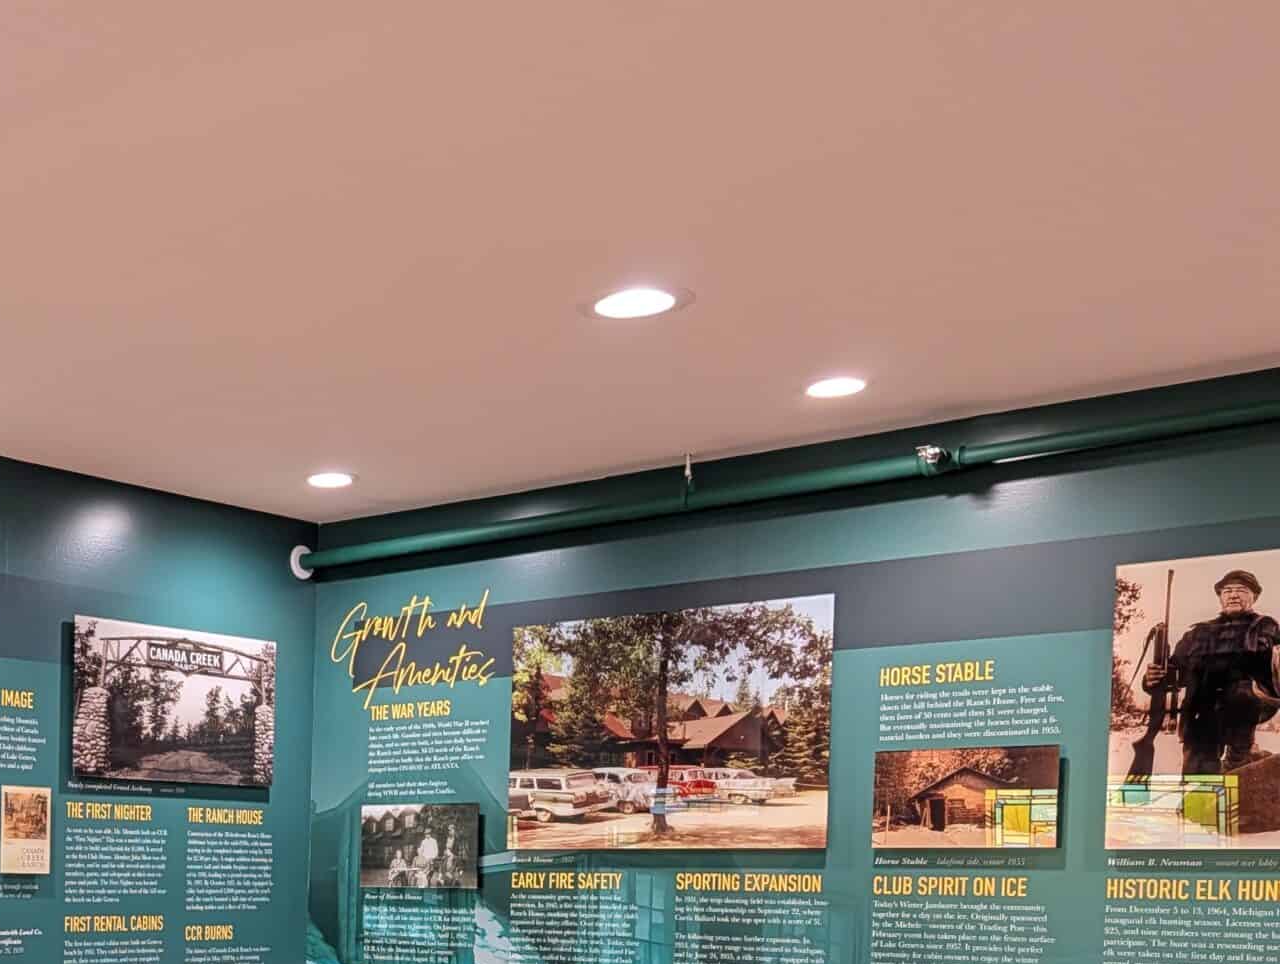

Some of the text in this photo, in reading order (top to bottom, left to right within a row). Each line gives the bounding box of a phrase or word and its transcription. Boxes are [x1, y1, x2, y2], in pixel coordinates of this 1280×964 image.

[330, 588, 490, 678] Growth and
[150, 647, 220, 667] CANADA CREEK
[352, 642, 496, 710] Amenities
[880, 660, 994, 687] HORSE STABLE
[0, 690, 34, 708] IMAGE
[371, 701, 450, 720] THE WAR YEARS
[67, 802, 152, 821] THE FIRST NIGHTER
[188, 808, 263, 826] THE RANCH HOUSE
[512, 872, 623, 890] EARLY FIRE SAFETY
[677, 874, 823, 893] SPORTING EXPANSION
[874, 876, 1026, 897] CLUB SPIRIT ON ICE
[1107, 879, 1280, 903] HISTORIC ELK HUN
[65, 916, 164, 932] FIRST RENTAL CABINS
[186, 926, 233, 940] CCR BURNS
